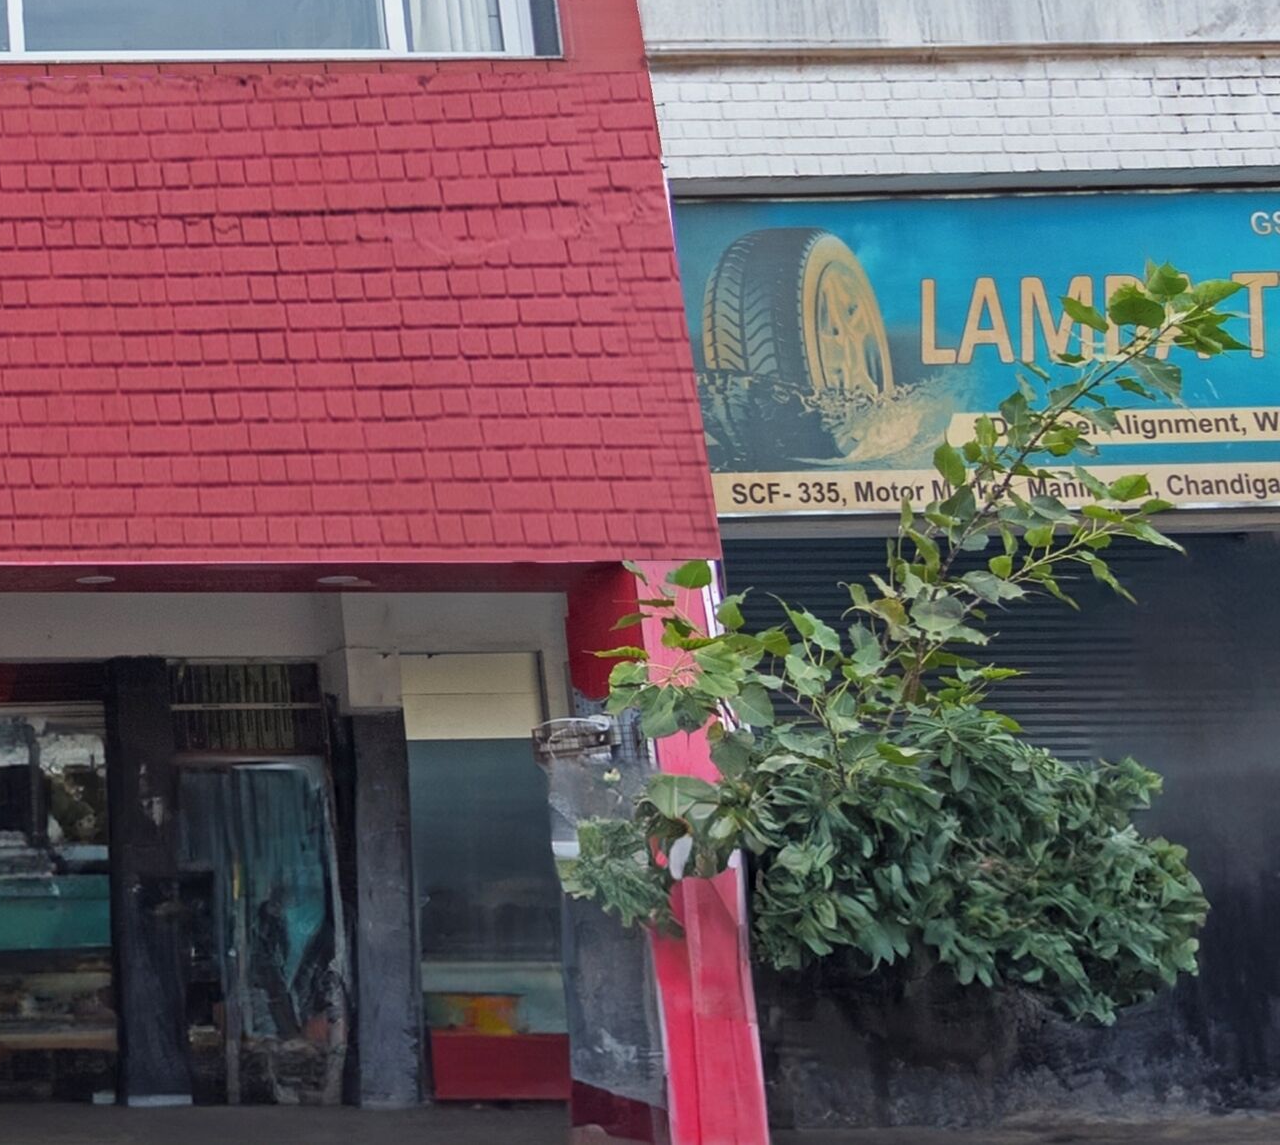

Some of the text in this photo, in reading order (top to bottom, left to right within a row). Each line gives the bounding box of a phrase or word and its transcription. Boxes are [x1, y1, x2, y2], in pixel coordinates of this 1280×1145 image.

[973, 417, 1008, 437] D
[731, 482, 791, 505] SCF-
[798, 481, 847, 506] 335,
[854, 481, 924, 503] Motor
